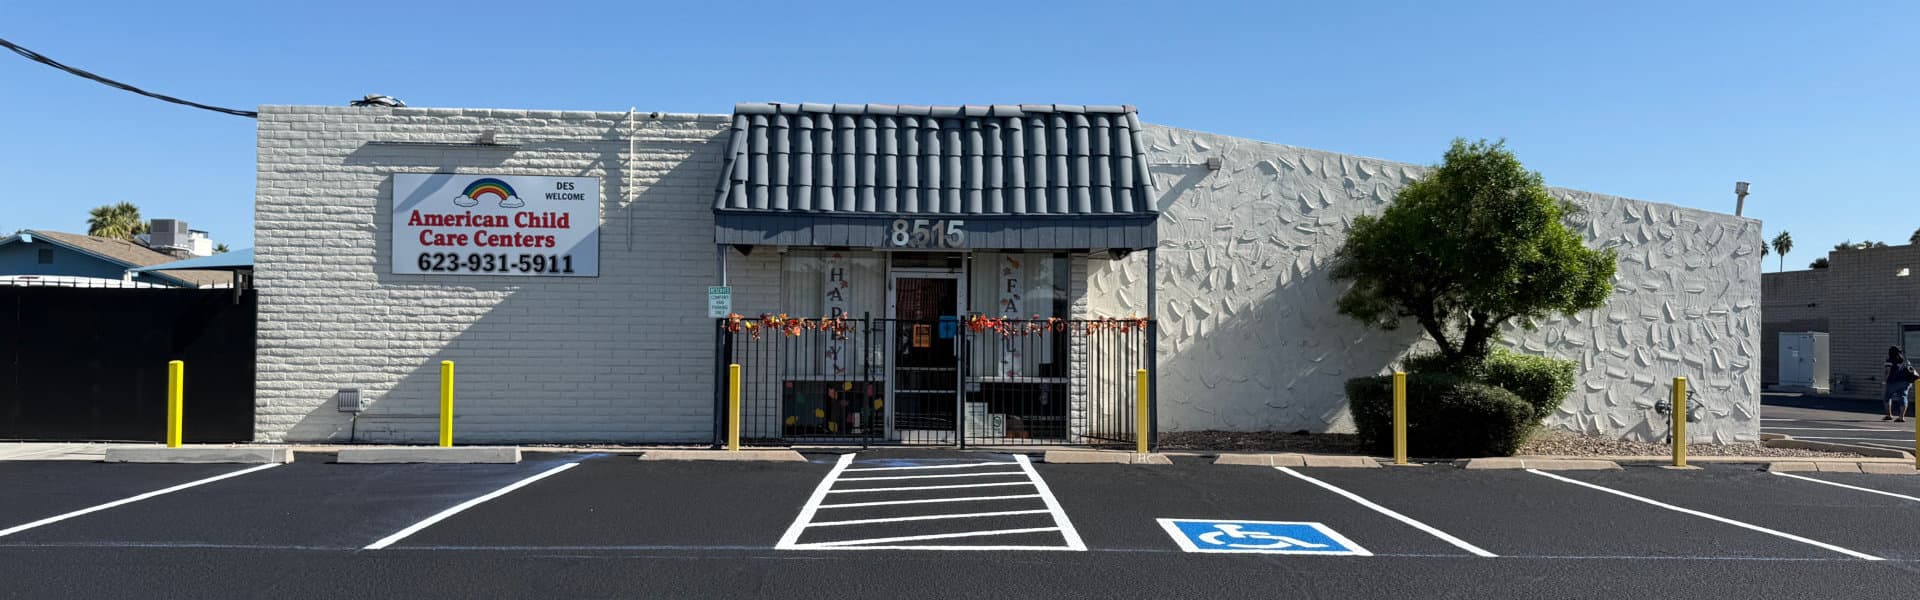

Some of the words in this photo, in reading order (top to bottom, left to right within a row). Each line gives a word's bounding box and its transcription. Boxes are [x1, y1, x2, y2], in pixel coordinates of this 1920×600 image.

[556, 182, 575, 191] DES
[545, 192, 585, 201] WELCOME
[408, 210, 509, 228] American
[514, 212, 570, 229] Child
[419, 230, 468, 247] Care
[473, 230, 555, 248] Centers
[891, 219, 965, 248] 8515
[418, 252, 574, 273] 623-931-5911
[829, 267, 844, 362] HAPY
